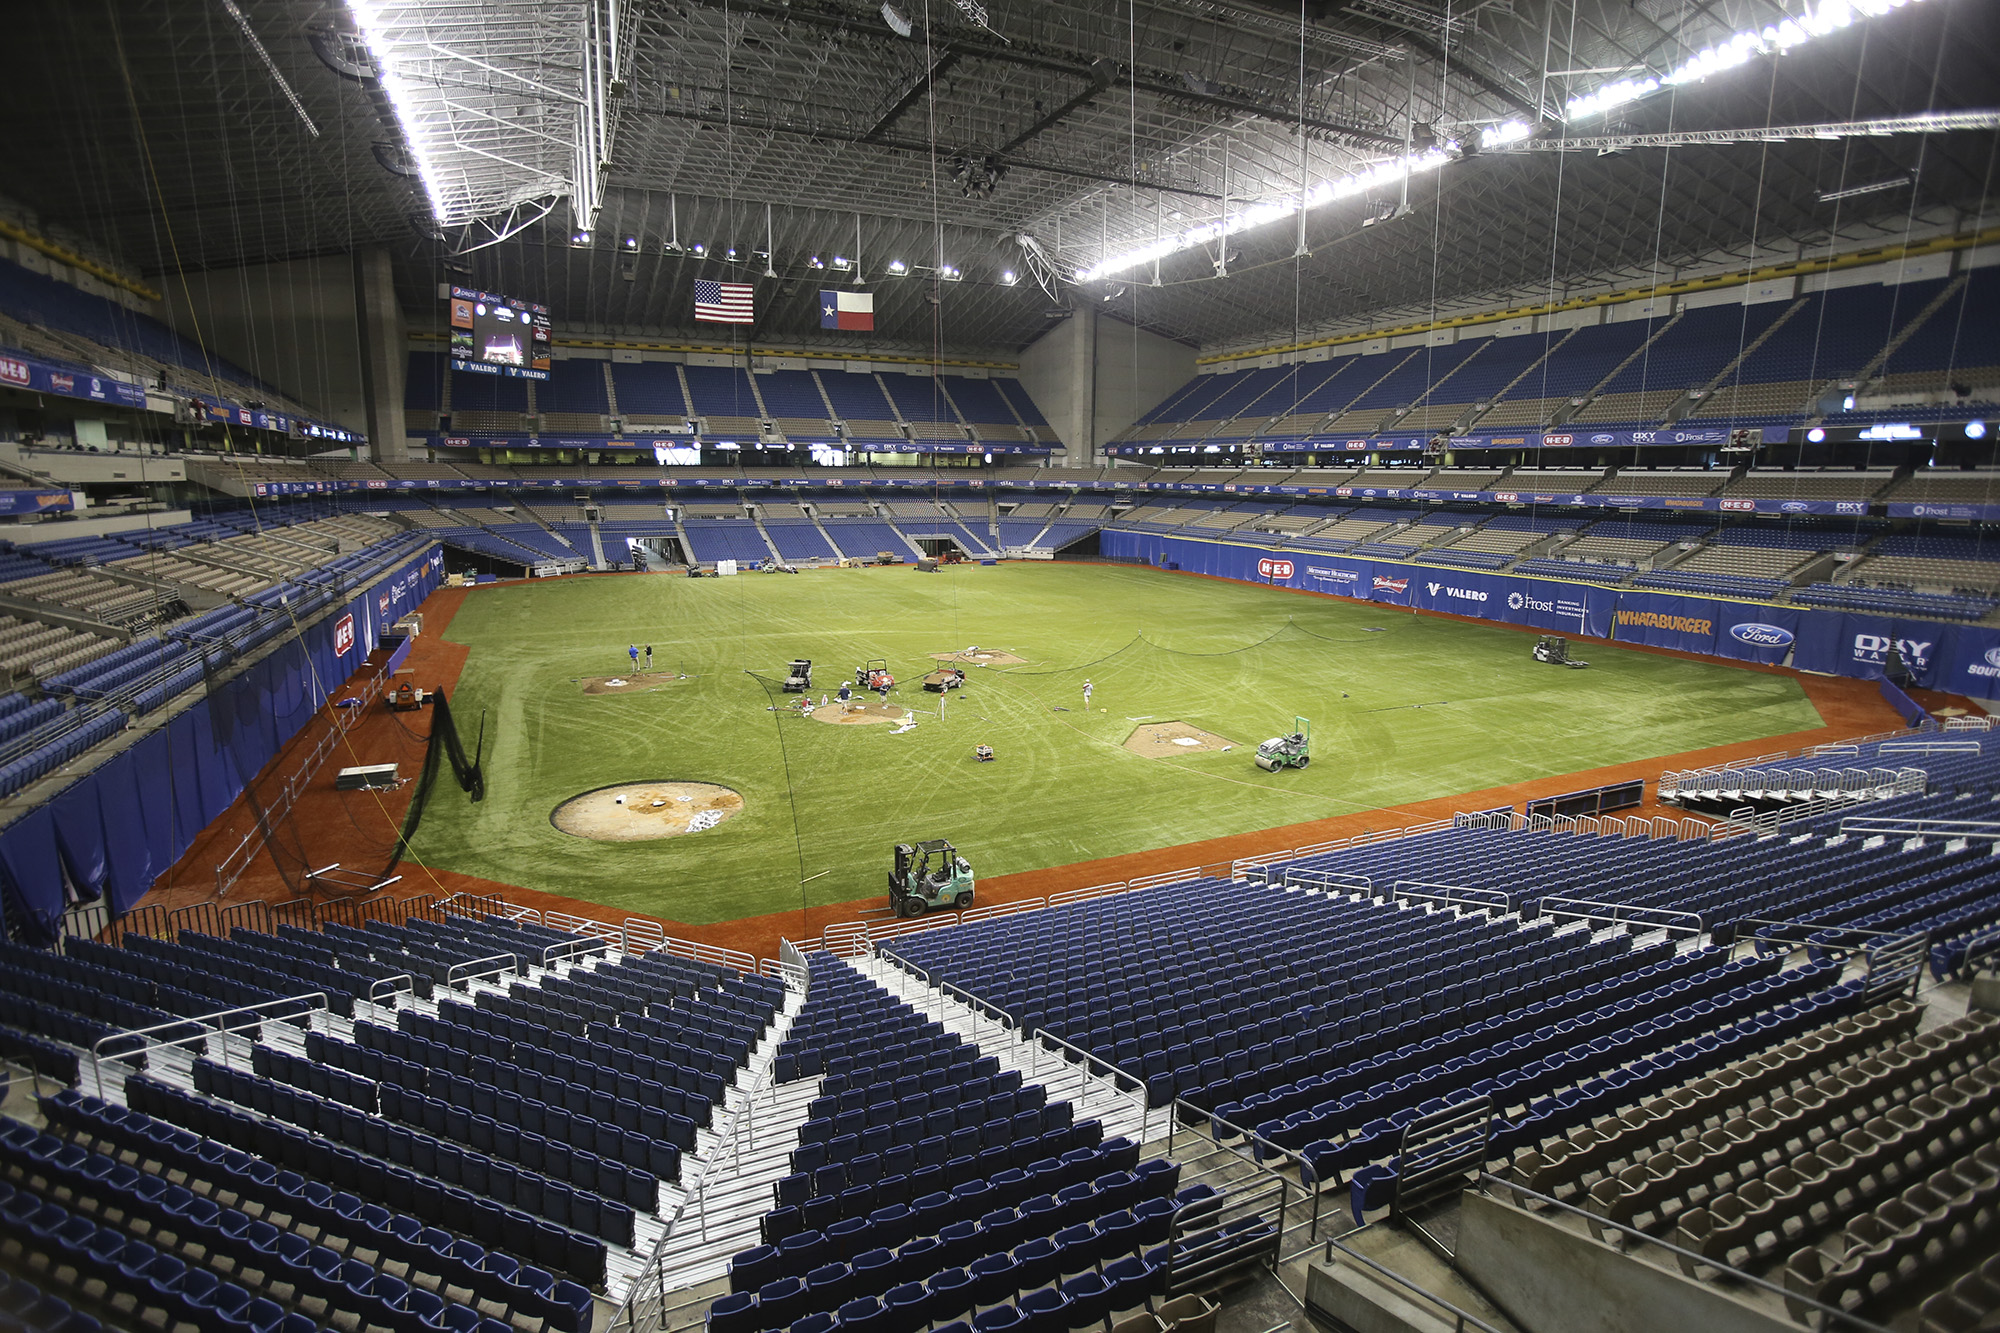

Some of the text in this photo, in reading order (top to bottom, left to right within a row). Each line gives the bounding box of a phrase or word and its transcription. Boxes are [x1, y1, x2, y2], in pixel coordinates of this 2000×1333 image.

[461, 290, 476, 298] pepsi
[470, 363, 497, 373] VALERO
[522, 370, 546, 379] VALERO
[1546, 436, 1570, 444] H-E-B
[1686, 433, 1703, 441] Frost
[1926, 507, 1948, 515] Frost
[1262, 564, 1290, 574] H-E-B
[1372, 576, 1407, 588] Budweiser
[1446, 587, 1487, 601] VALERO
[1524, 596, 1553, 612] Frost
[1617, 611, 1712, 635] WHATABURGER
[337, 622, 352, 648] H-E-B
[1742, 626, 1782, 644] Ford
